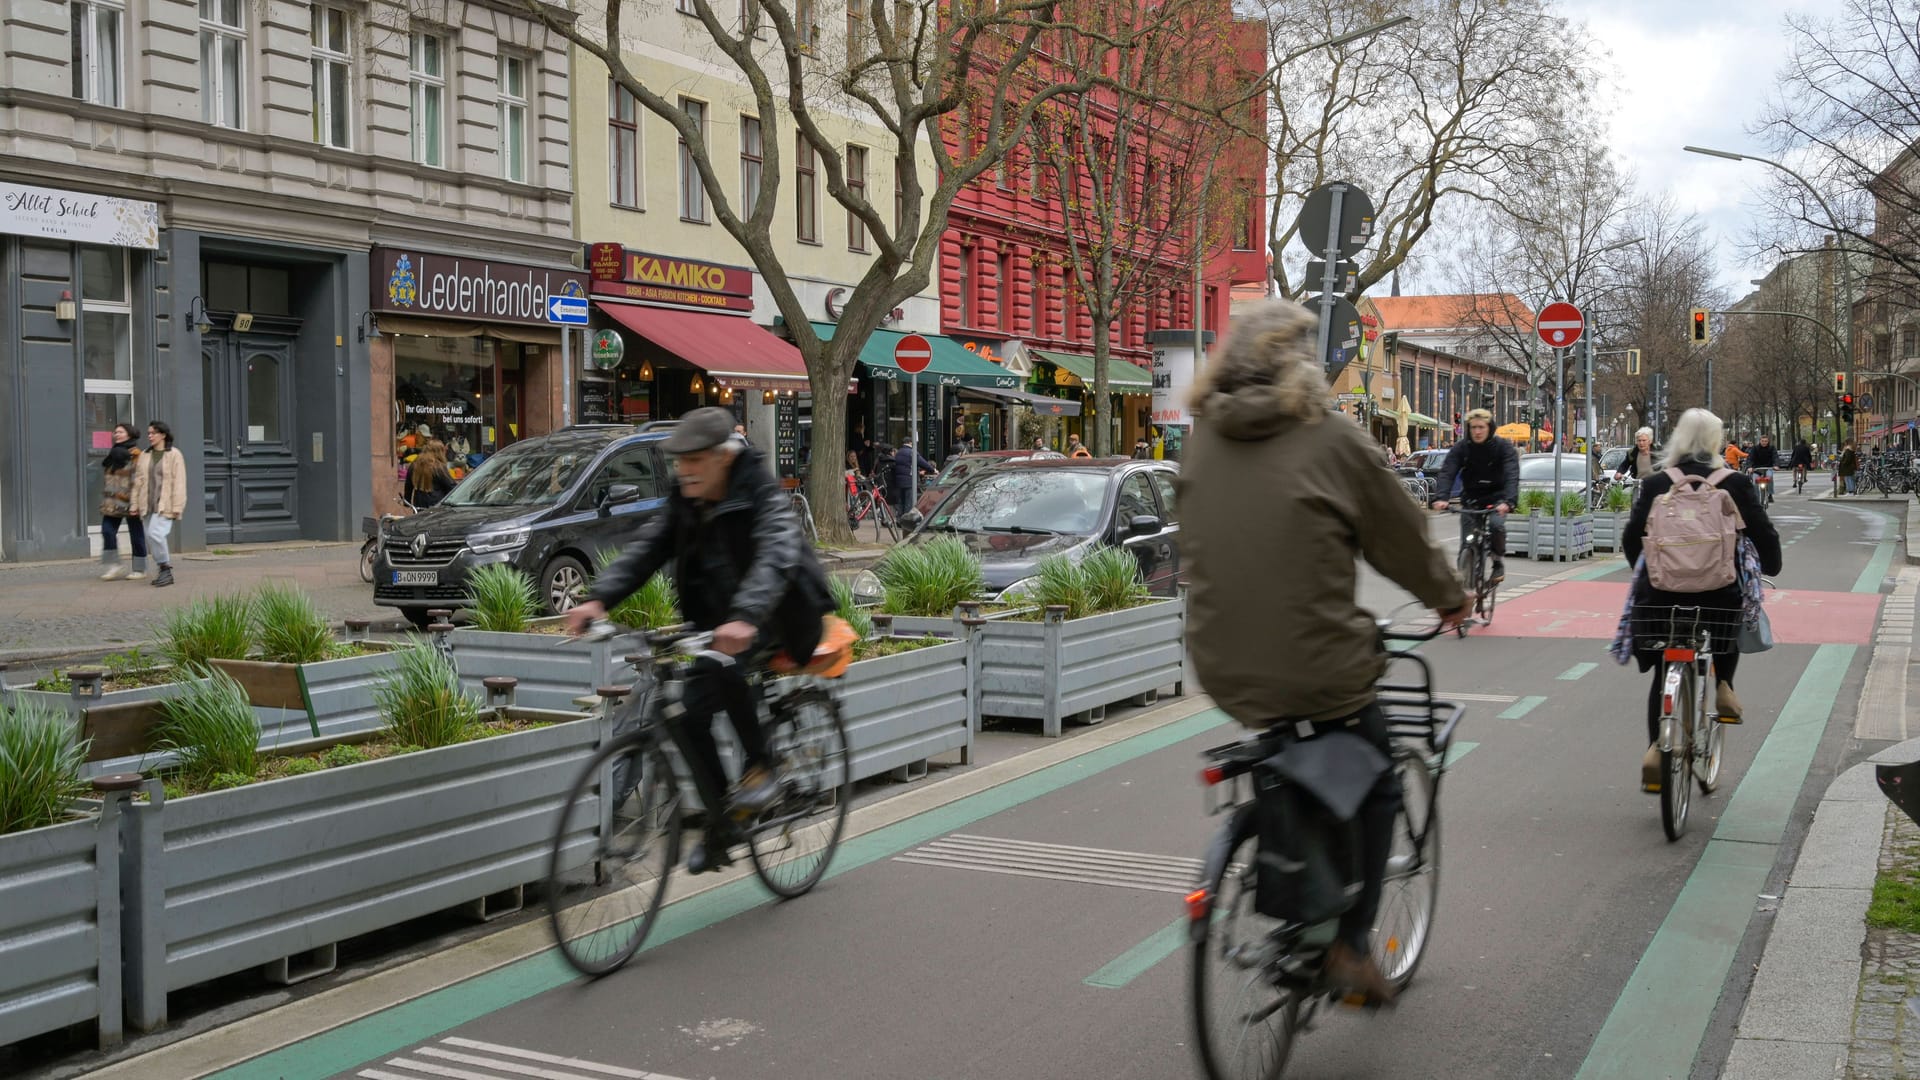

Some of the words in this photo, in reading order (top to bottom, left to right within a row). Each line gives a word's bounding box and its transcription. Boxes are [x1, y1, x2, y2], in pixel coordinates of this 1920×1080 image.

[6, 191, 53, 214] Allet
[41, 226, 67, 235] BERLIN
[633, 255, 726, 290] KAMIKO
[419, 256, 551, 321] Lederhandel
[626, 285, 642, 295] SUSHI
[645, 287, 658, 298] ASIA
[658, 289, 677, 300] FUSION
[677, 291, 697, 303] KITCHEN
[701, 295, 727, 306] COCKTAILS
[240, 320, 249, 328] 90
[731, 379, 755, 387] KAMIKO
[405, 405, 414, 414] Ihr
[415, 405, 435, 414] Gürtel
[436, 406, 450, 414] nach
[451, 406, 463, 415] Maß
[442, 415, 452, 423] bei
[453, 416, 463, 424] uns
[464, 415, 483, 424] sofort!
